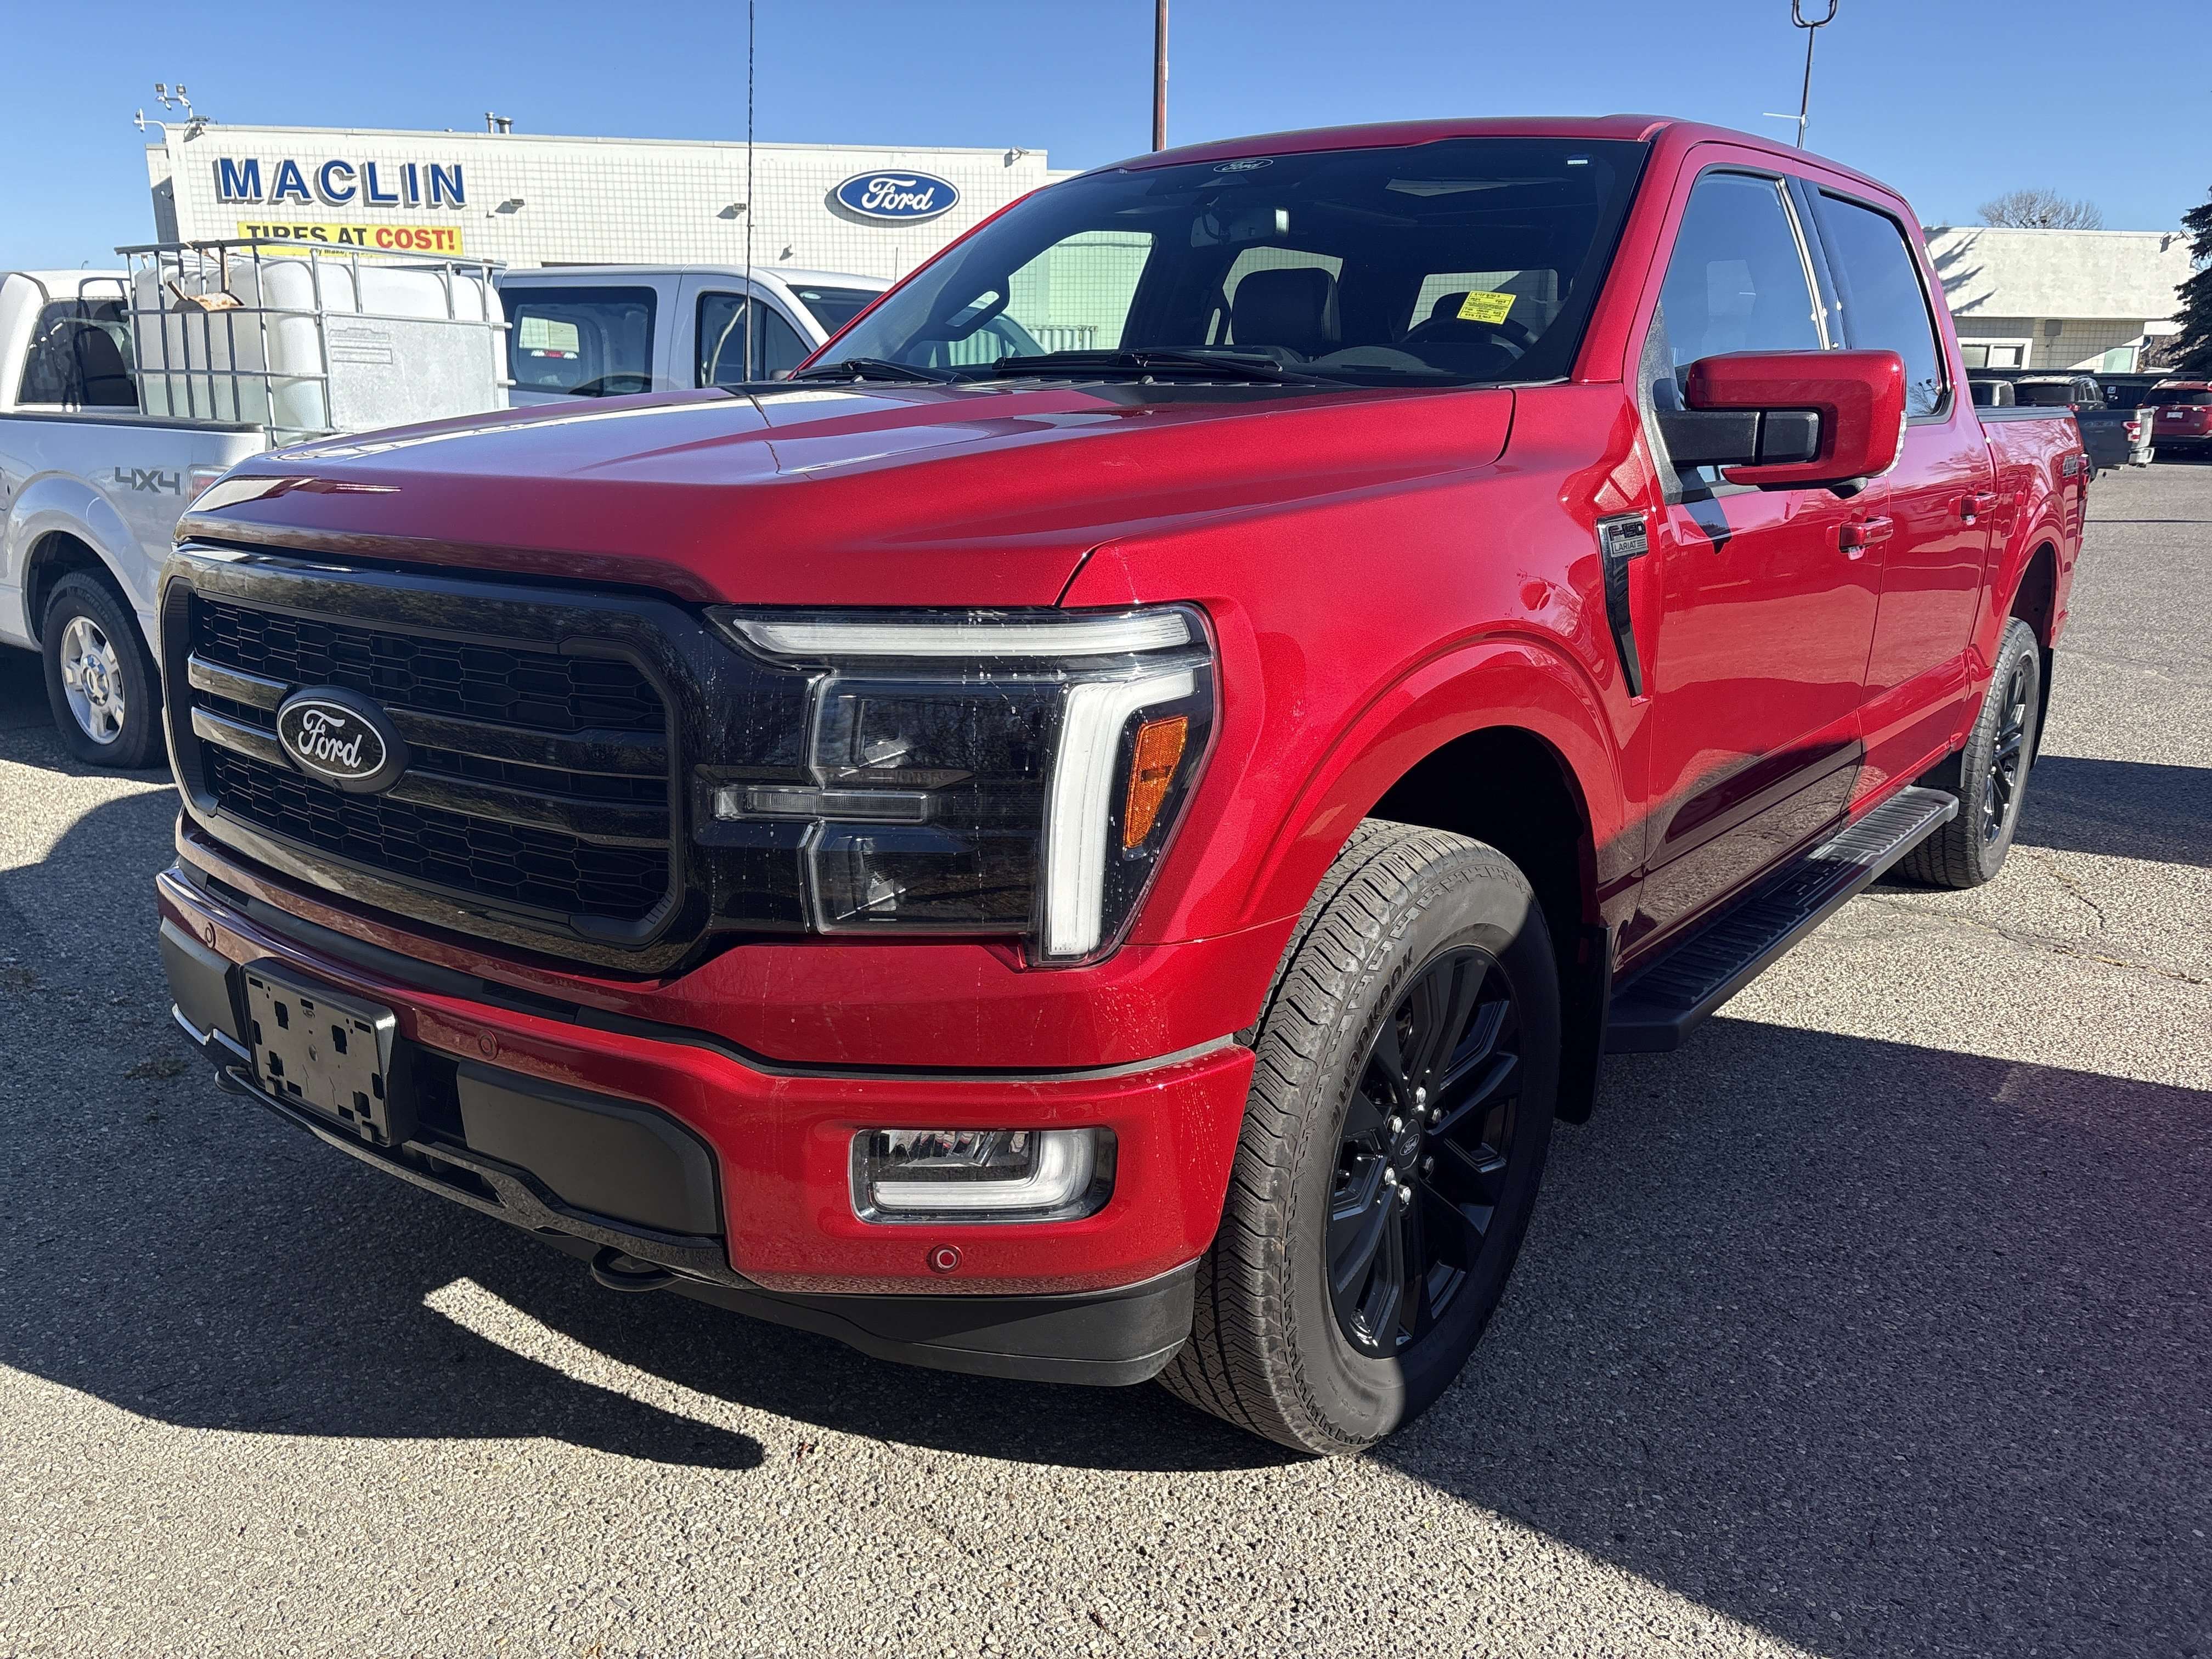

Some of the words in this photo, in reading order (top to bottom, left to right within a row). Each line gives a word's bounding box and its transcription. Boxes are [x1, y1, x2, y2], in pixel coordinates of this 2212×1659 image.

[217, 157, 466, 206] MACLIN
[861, 177, 935, 211] Ford
[337, 227, 367, 246] AT
[375, 228, 455, 250] COST!
[1615, 541, 1637, 551] LARIAT
[297, 709, 363, 768] Ford
